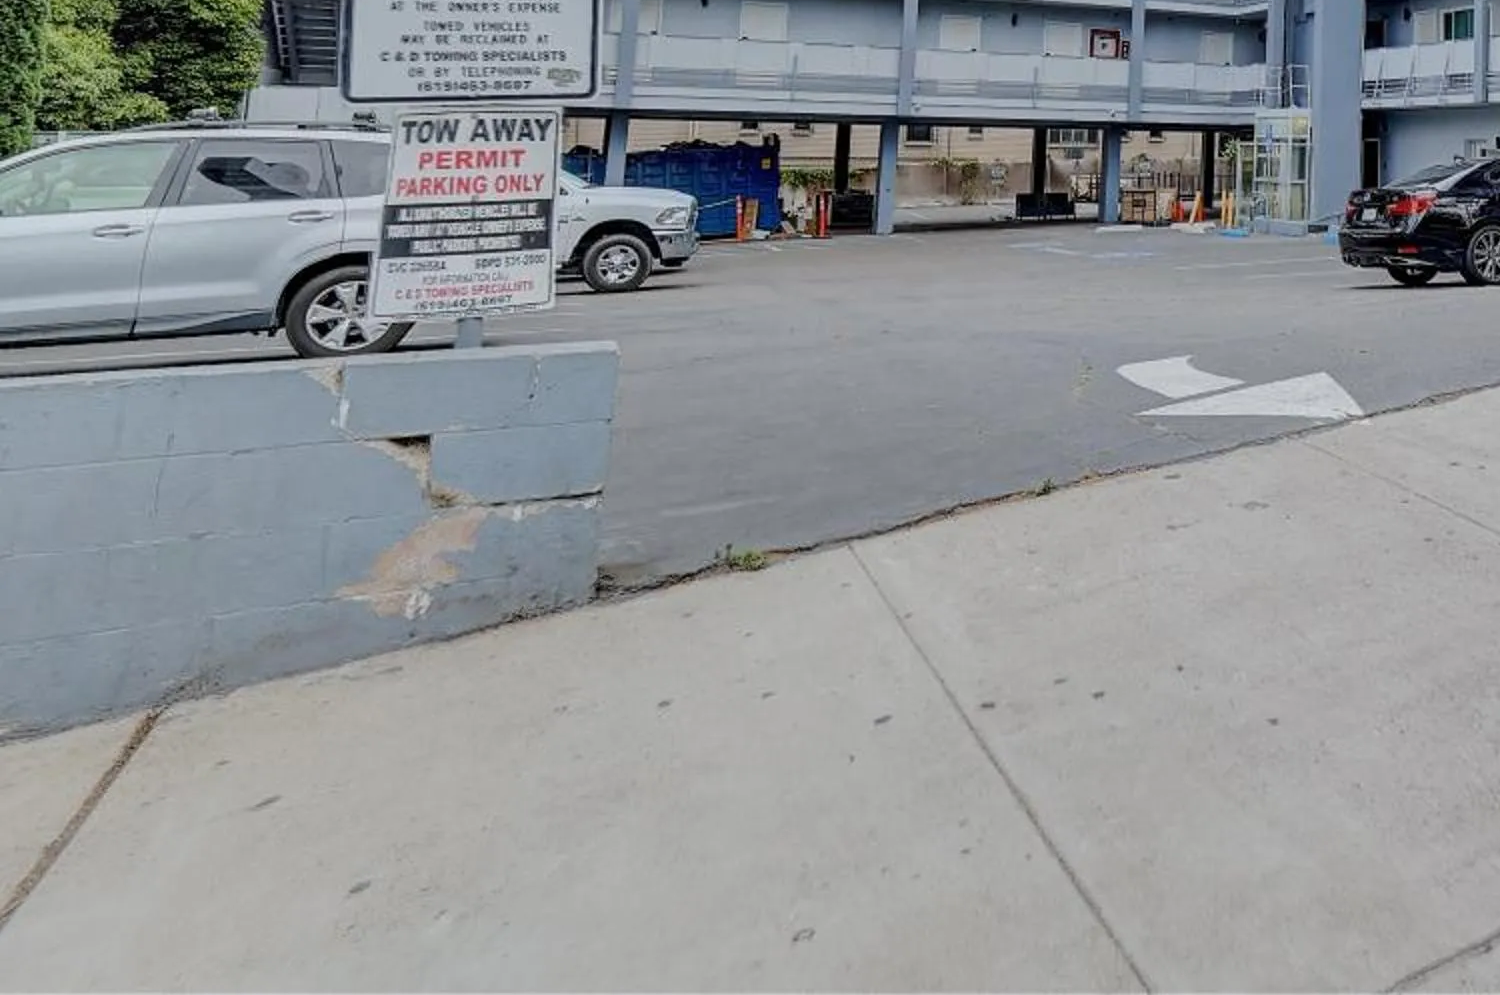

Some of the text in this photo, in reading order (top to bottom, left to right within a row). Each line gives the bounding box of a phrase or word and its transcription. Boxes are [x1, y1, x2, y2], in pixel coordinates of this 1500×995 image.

[390, 0, 405, 11] AT
[415, 1, 437, 12] THE
[508, 2, 561, 14] EXPENSE
[424, 20, 530, 32] TOWED VEHICLES
[401, 34, 549, 45] MAY BE RECLAIMED AT
[381, 50, 567, 62] C & D TOWING SPECIALISTS
[408, 66, 425, 78] OR
[433, 66, 449, 78] BY
[461, 66, 541, 78] TELEPHONING
[402, 118, 553, 145] TOW AWAY
[418, 150, 526, 171] PERMIT
[396, 173, 544, 197] PARKING ONLY
[394, 289, 403, 300] C
[424, 285, 469, 299] TOWING
[472, 280, 534, 295] SPECIALISTS
